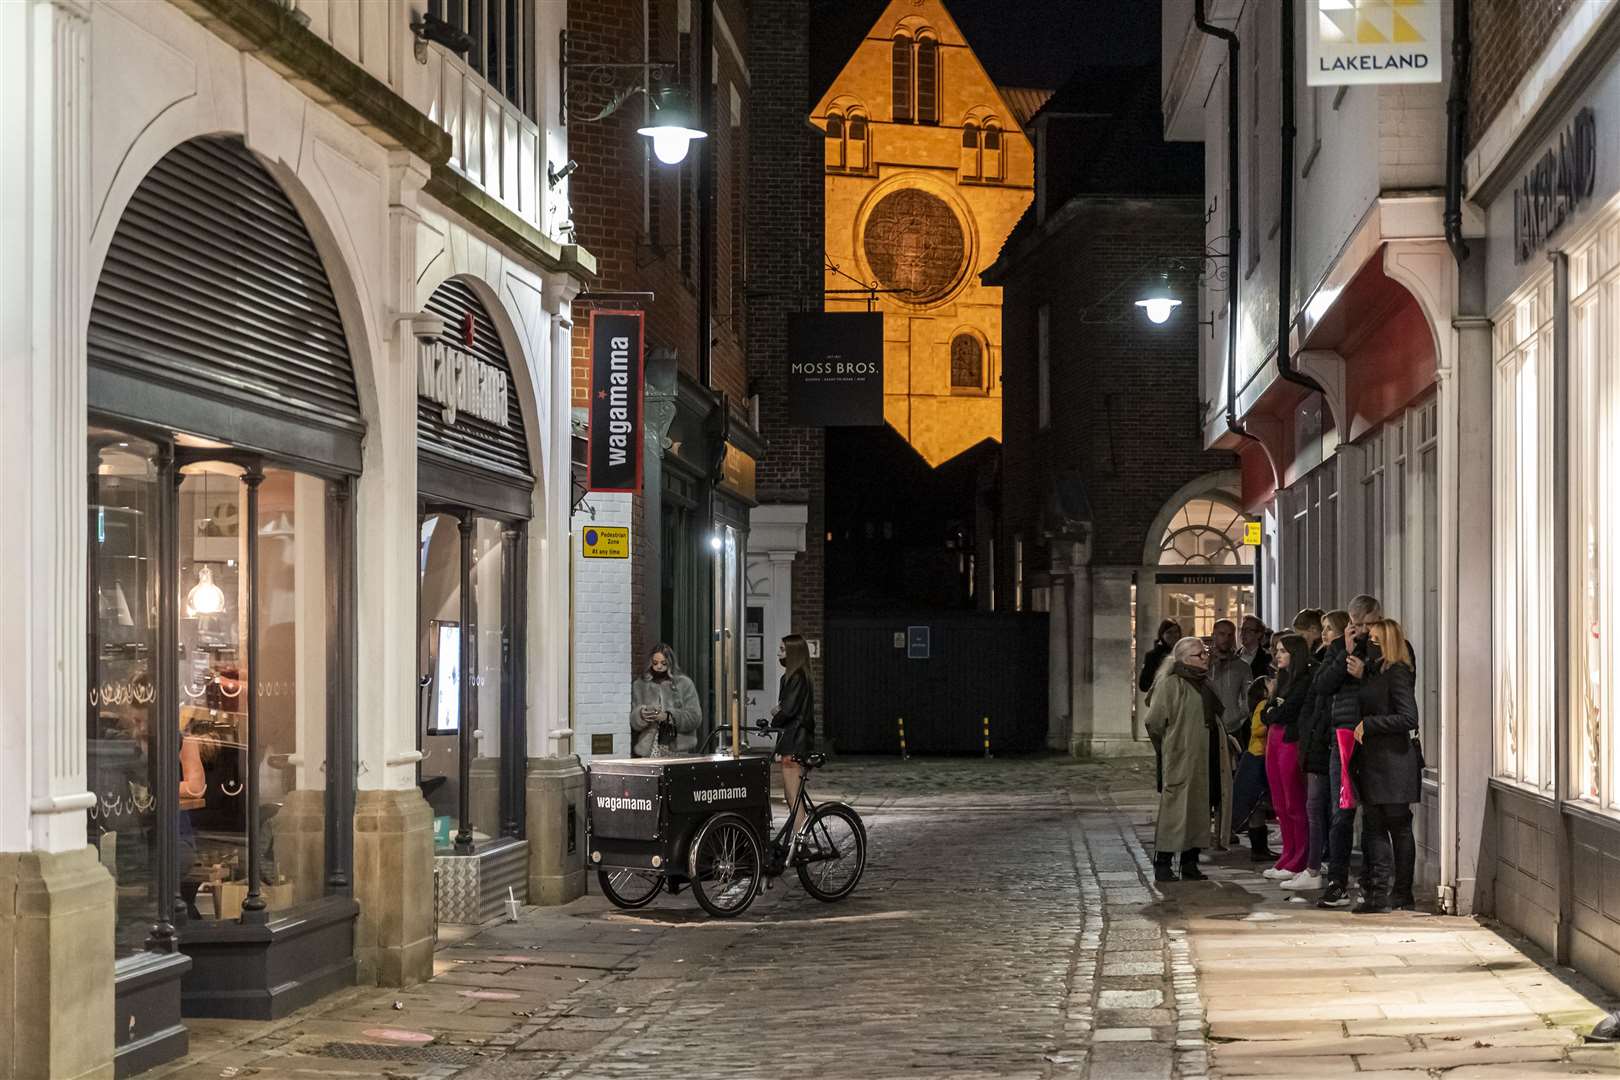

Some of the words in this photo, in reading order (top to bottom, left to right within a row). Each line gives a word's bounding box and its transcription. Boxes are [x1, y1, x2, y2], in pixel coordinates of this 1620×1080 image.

[1319, 54, 1428, 71] LAKELAND
[1513, 107, 1597, 266] LAKELAND
[791, 362, 832, 374] MOSS
[836, 362, 879, 374] BROS.
[418, 341, 509, 427] wagamama
[608, 336, 632, 467] wagamama
[596, 795, 652, 812] wagamama
[693, 786, 747, 804] wagamama
